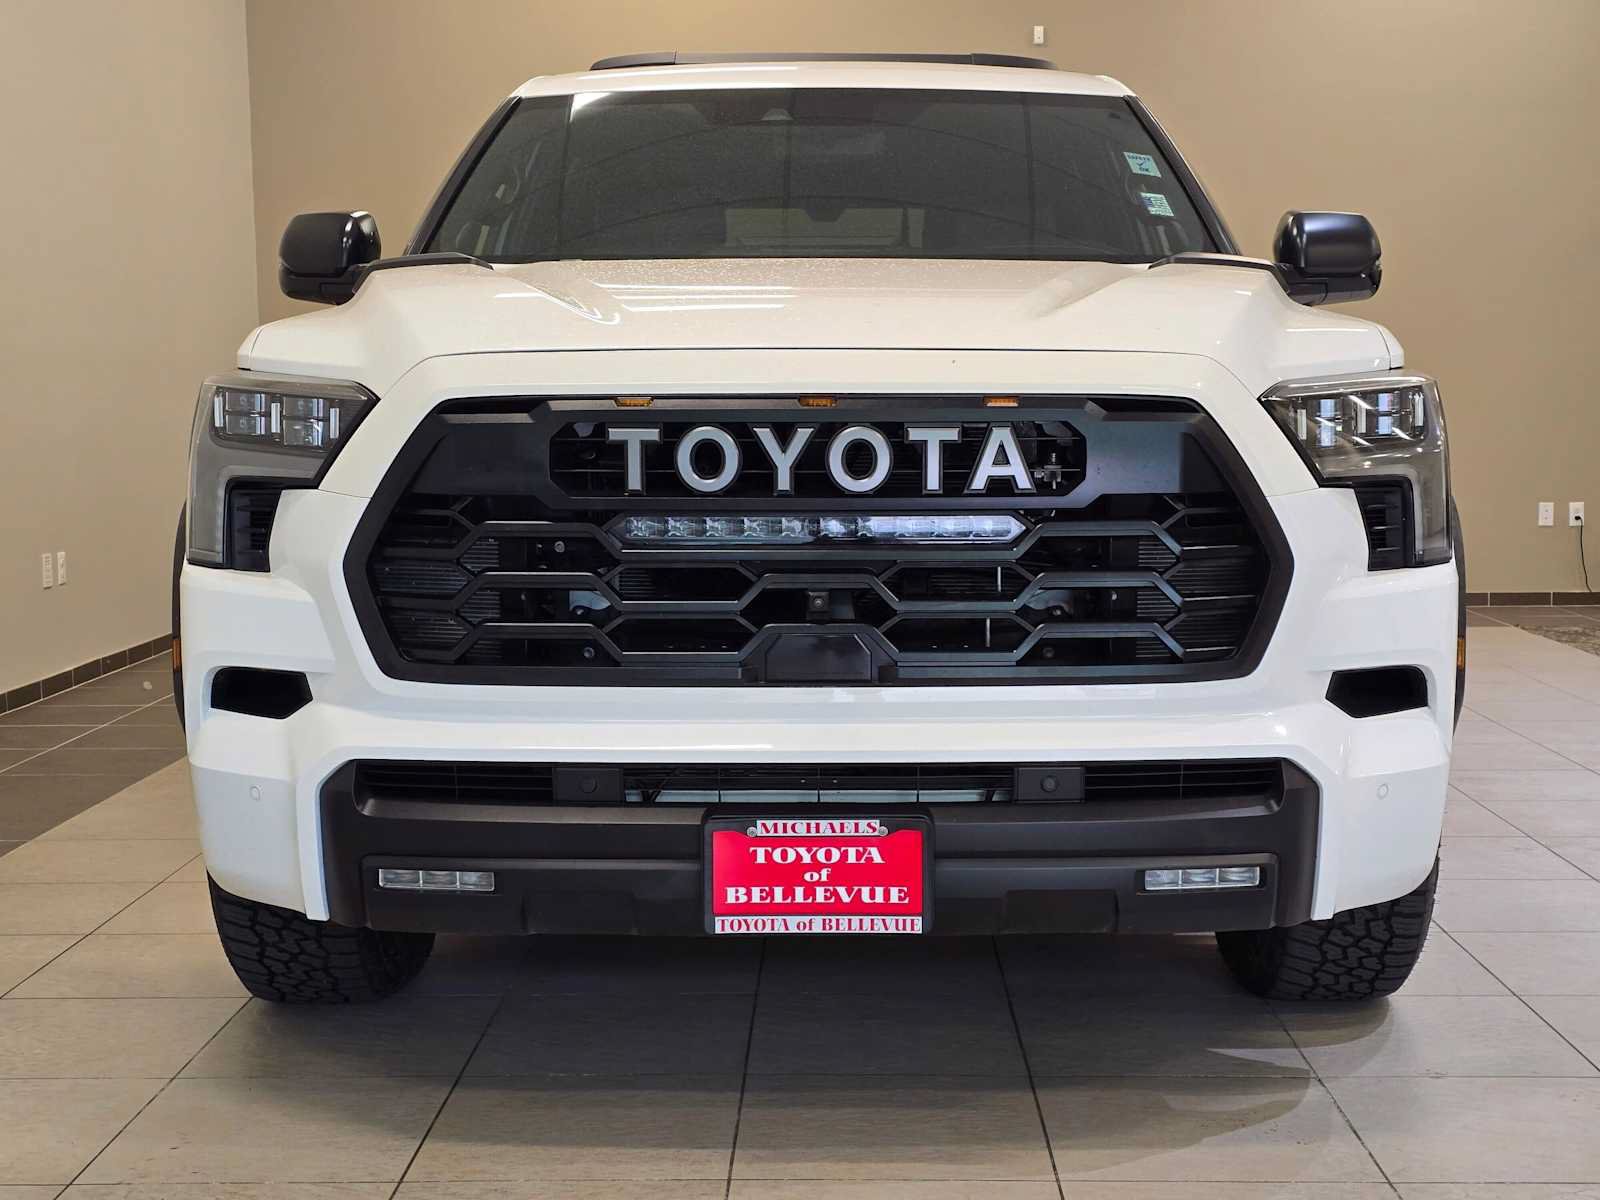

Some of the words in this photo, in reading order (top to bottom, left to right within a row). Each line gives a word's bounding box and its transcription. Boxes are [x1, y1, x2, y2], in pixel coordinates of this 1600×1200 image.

[607, 425, 1036, 494] TOYOTA
[759, 821, 878, 835] MICHAELS
[750, 847, 885, 864] TOYOTA
[803, 868, 831, 882] of
[725, 886, 909, 904] BELLEVUE
[717, 918, 789, 932] TOYOTA
[796, 918, 815, 932] of
[822, 918, 921, 932] BELLEVUE
